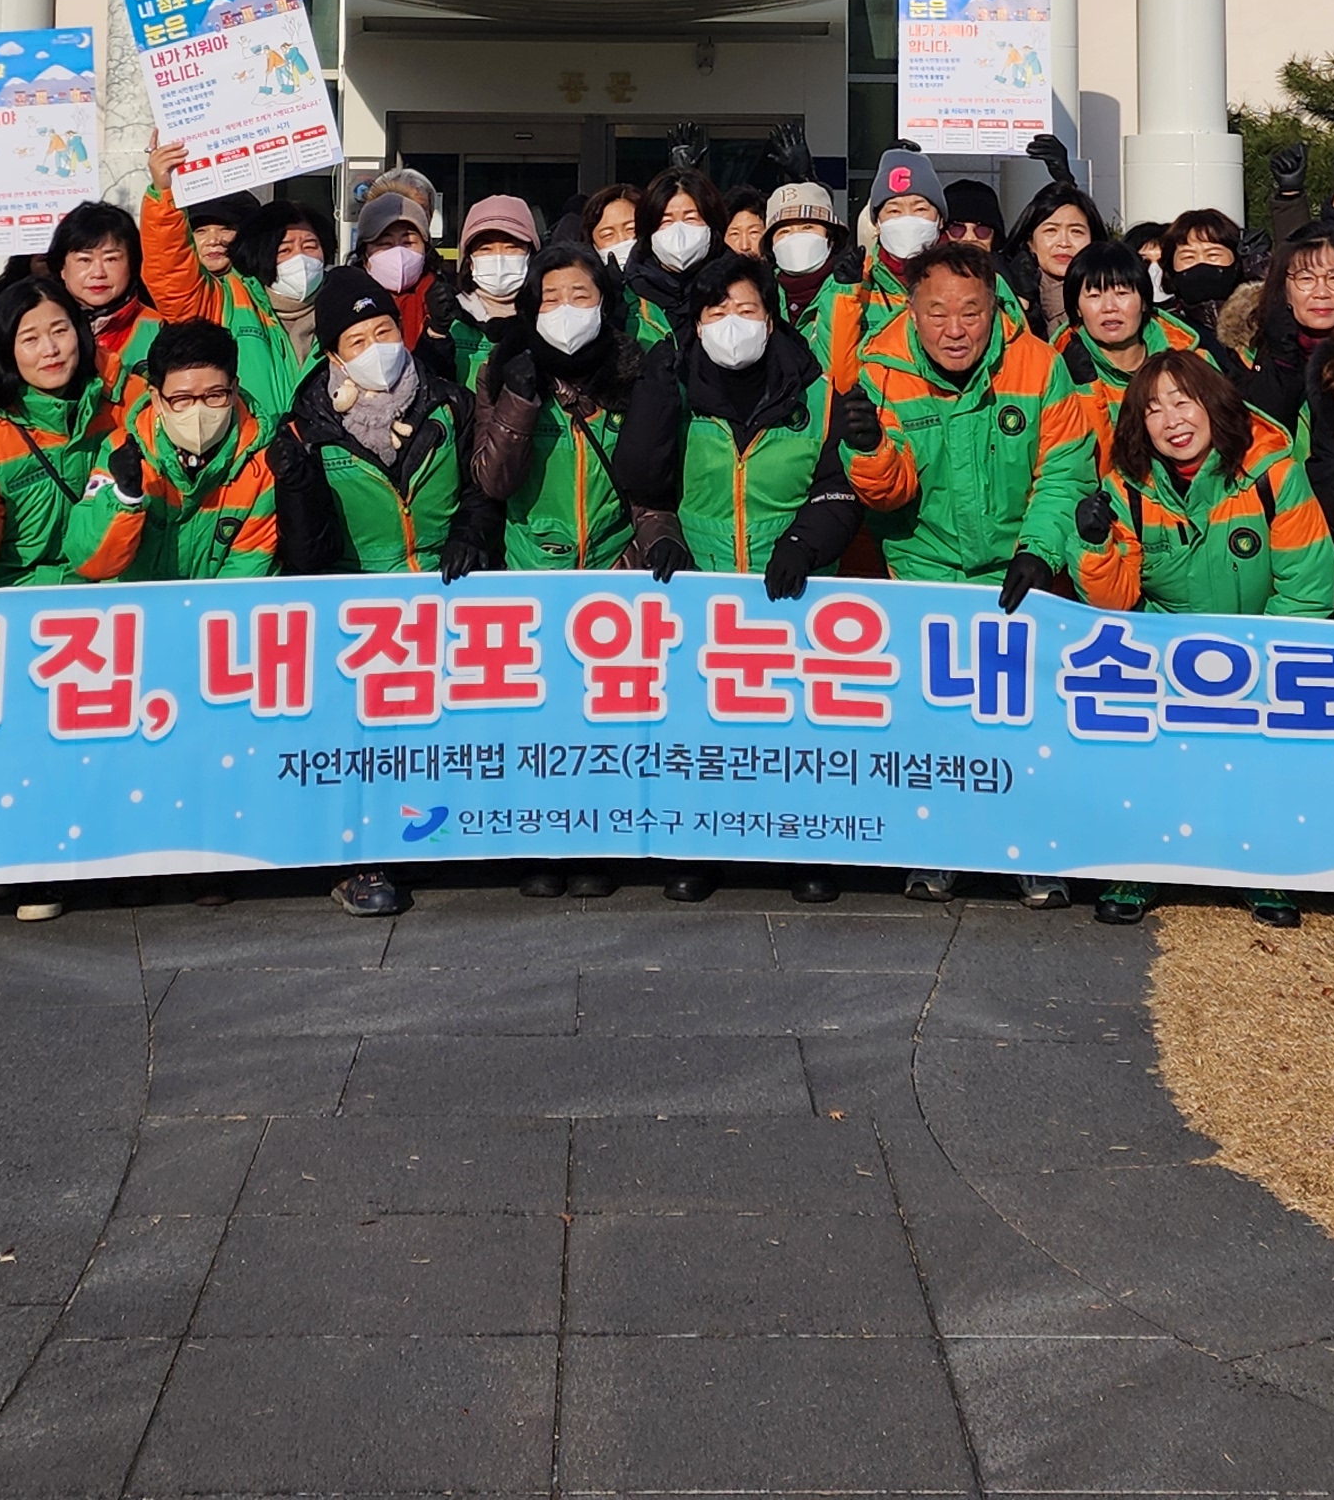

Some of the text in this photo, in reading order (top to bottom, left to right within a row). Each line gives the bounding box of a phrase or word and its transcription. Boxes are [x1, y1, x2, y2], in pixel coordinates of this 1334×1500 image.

[137, 0, 155, 20] 내
[142, 13, 189, 46] 눈은
[149, 33, 229, 69] 내가 치워야
[154, 60, 204, 87] 합니다.
[826, 491, 856, 502] balance
[36, 611, 172, 733] 집,
[205, 607, 309, 711] 내
[345, 602, 541, 718] 점포
[572, 599, 676, 716] 앞
[704, 599, 893, 720] 눈은
[928, 619, 1028, 719] 내
[278, 742, 1013, 795] 자연재해대책법 제27조(건축물관리자의 제설책임)
[458, 807, 885, 842] 인천광역시 연수구 지역자율방재단
